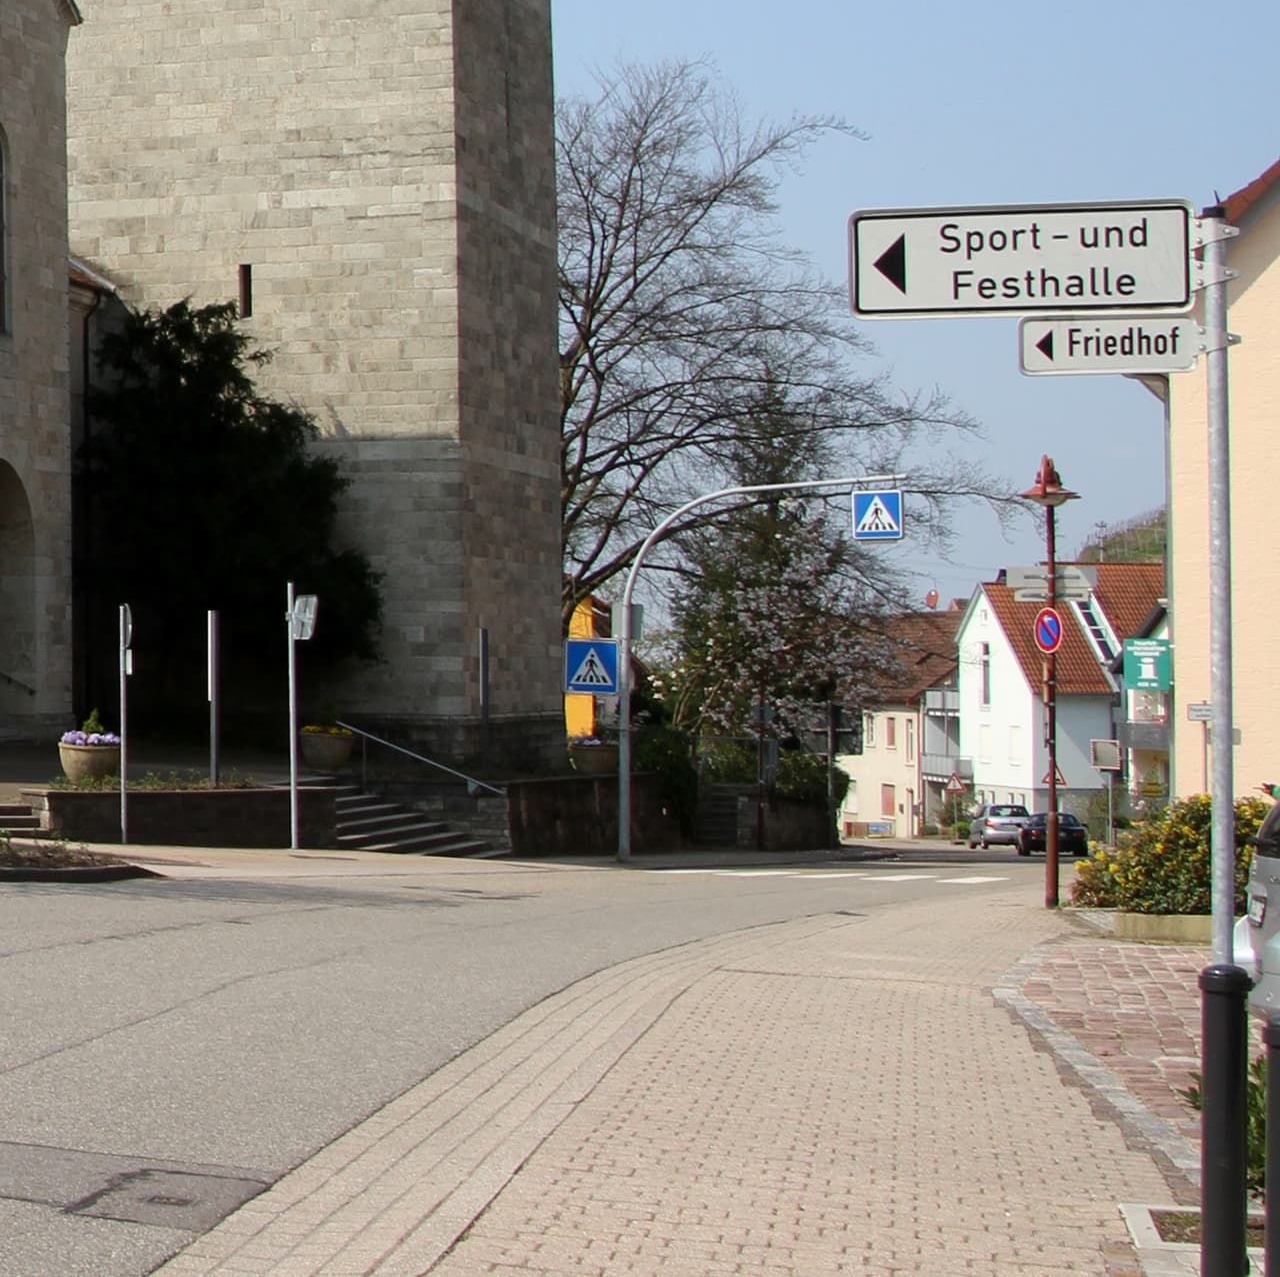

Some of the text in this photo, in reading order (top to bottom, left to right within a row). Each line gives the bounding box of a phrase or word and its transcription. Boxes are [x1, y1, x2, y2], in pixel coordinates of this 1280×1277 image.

[939, 222, 1041, 261] Sport
[1080, 217, 1149, 249] und
[952, 266, 1137, 301] Festhalle
[1068, 326, 1180, 358] Friedhof
